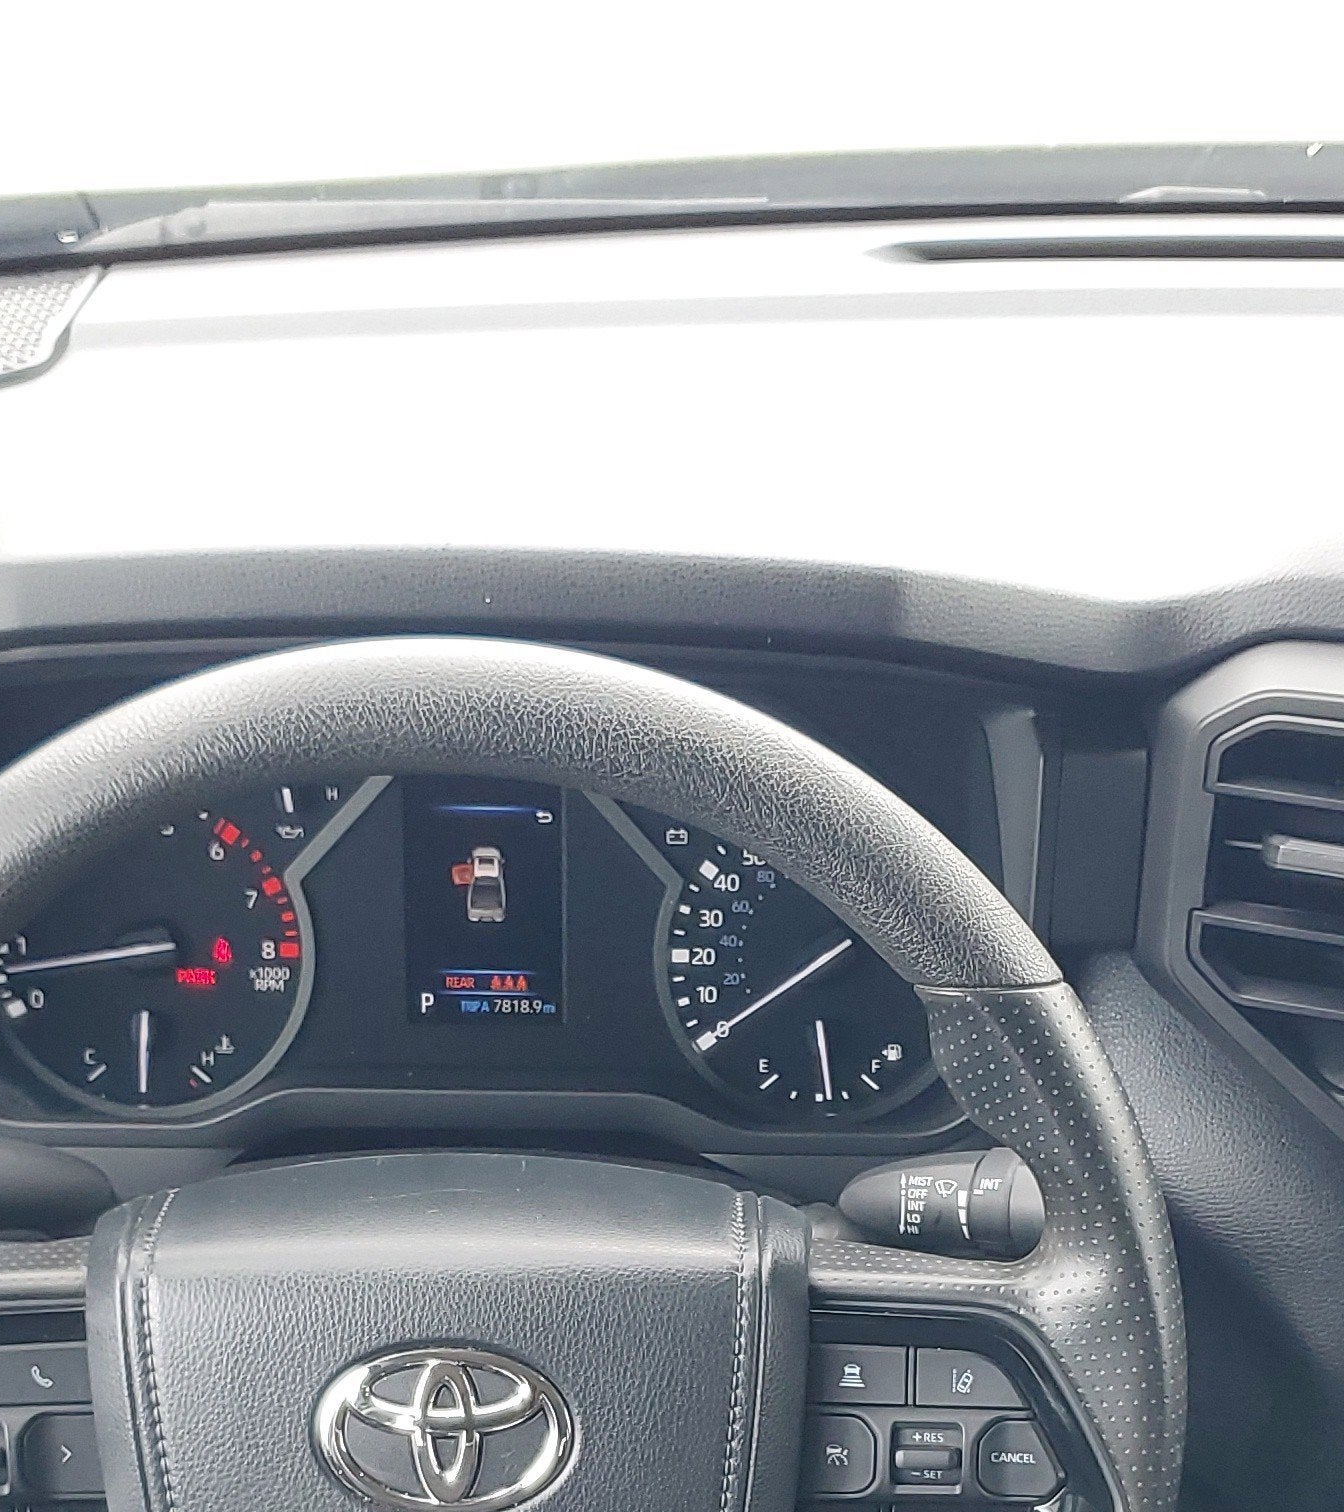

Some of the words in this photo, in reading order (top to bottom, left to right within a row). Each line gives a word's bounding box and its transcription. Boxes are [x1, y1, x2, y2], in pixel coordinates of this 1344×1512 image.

[209, 843, 225, 862] 6
[714, 874, 740, 893] 40
[757, 870, 775, 883] 80
[245, 890, 259, 909] 7
[731, 901, 749, 913] 60
[698, 910, 724, 928] 30
[15, 936, 27, 956] 1
[719, 934, 738, 948] 40
[260, 940, 277, 960] 8
[691, 947, 716, 966] 20
[253, 979, 286, 993] RPM
[445, 976, 475, 989] REAR
[723, 973, 740, 985] 20
[29, 989, 45, 1009] 0
[695, 986, 717, 1004] 10
[421, 993, 435, 1014] P
[493, 998, 543, 1014] 7818.9
[716, 1020, 730, 1039] 0
[84, 1048, 97, 1065] C
[201, 1051, 216, 1067] H
[759, 1058, 770, 1074] E
[871, 1059, 882, 1074] F
[908, 1175, 934, 1187] MIST
[979, 1178, 1003, 1191] INT
[907, 1188, 929, 1200] OFF
[907, 1200, 927, 1212] INT
[906, 1212, 922, 1224] LO
[906, 1224, 920, 1235] HI
[990, 1451, 1037, 1465] CANCEL
